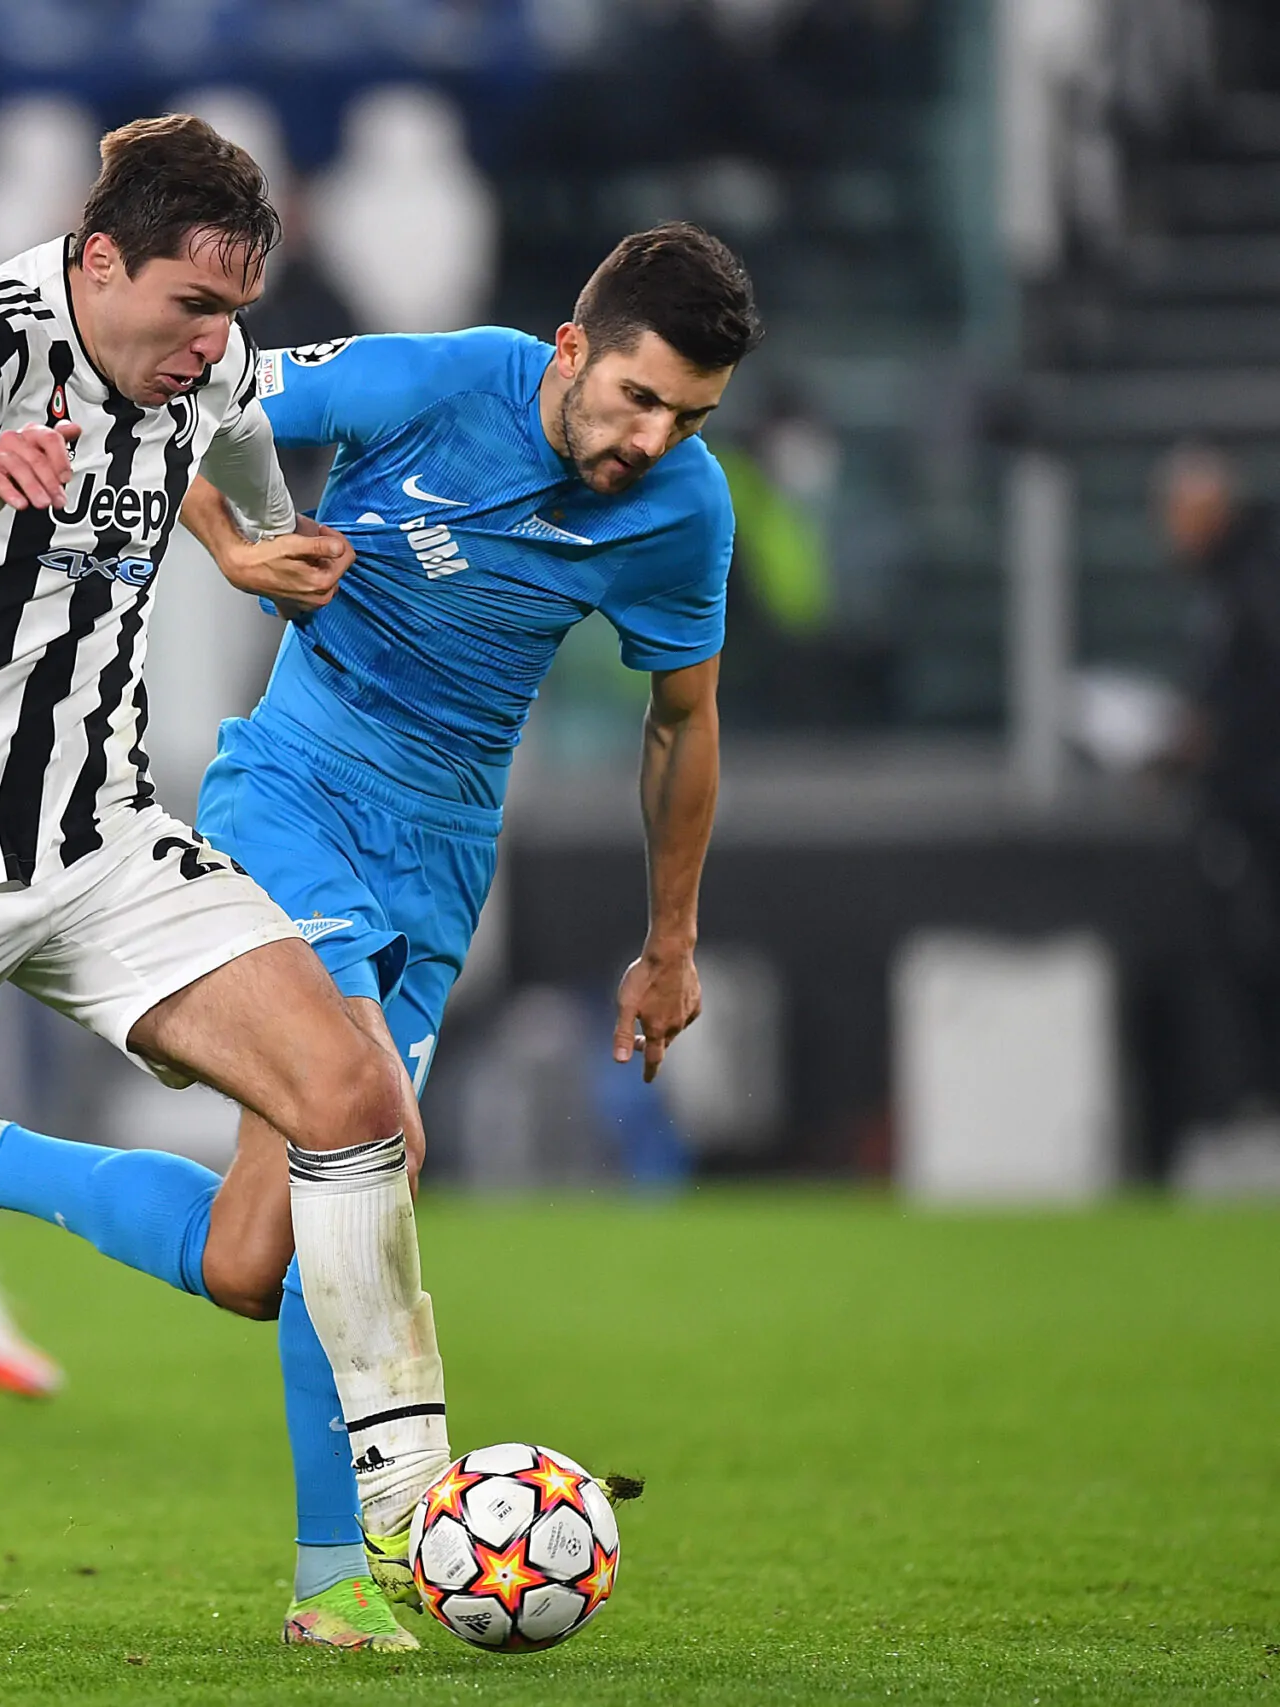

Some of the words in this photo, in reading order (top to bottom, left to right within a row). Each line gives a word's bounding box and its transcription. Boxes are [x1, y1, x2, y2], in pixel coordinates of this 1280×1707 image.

[50, 472, 169, 541] Jeep
[153, 836, 250, 881] 2
[408, 1034, 435, 1097] 1
